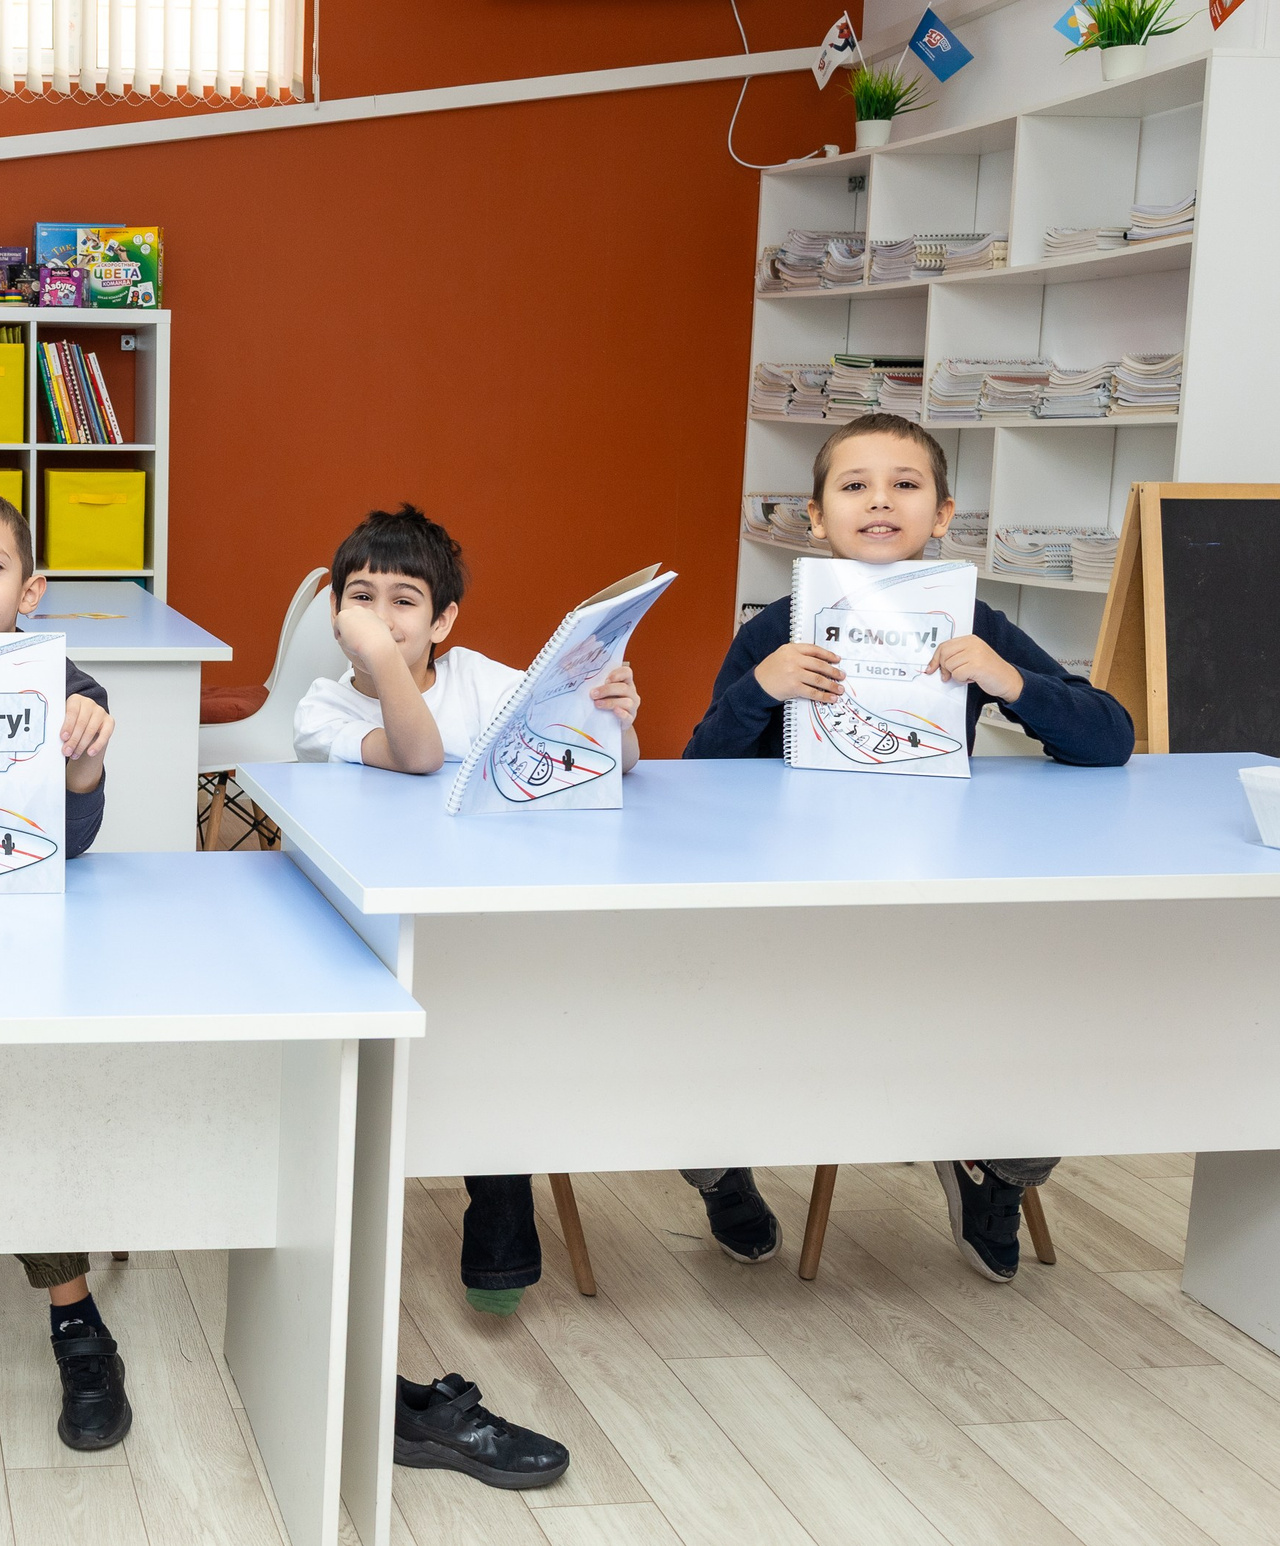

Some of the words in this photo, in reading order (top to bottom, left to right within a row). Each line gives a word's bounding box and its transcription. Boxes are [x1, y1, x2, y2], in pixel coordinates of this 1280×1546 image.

[94, 268, 140, 280] ЦВЕТА
[44, 281, 76, 293] Азбука
[825, 626, 840, 642] я
[848, 627, 938, 653] смогу!
[855, 663, 861, 673] 1
[866, 664, 907, 676] часть
